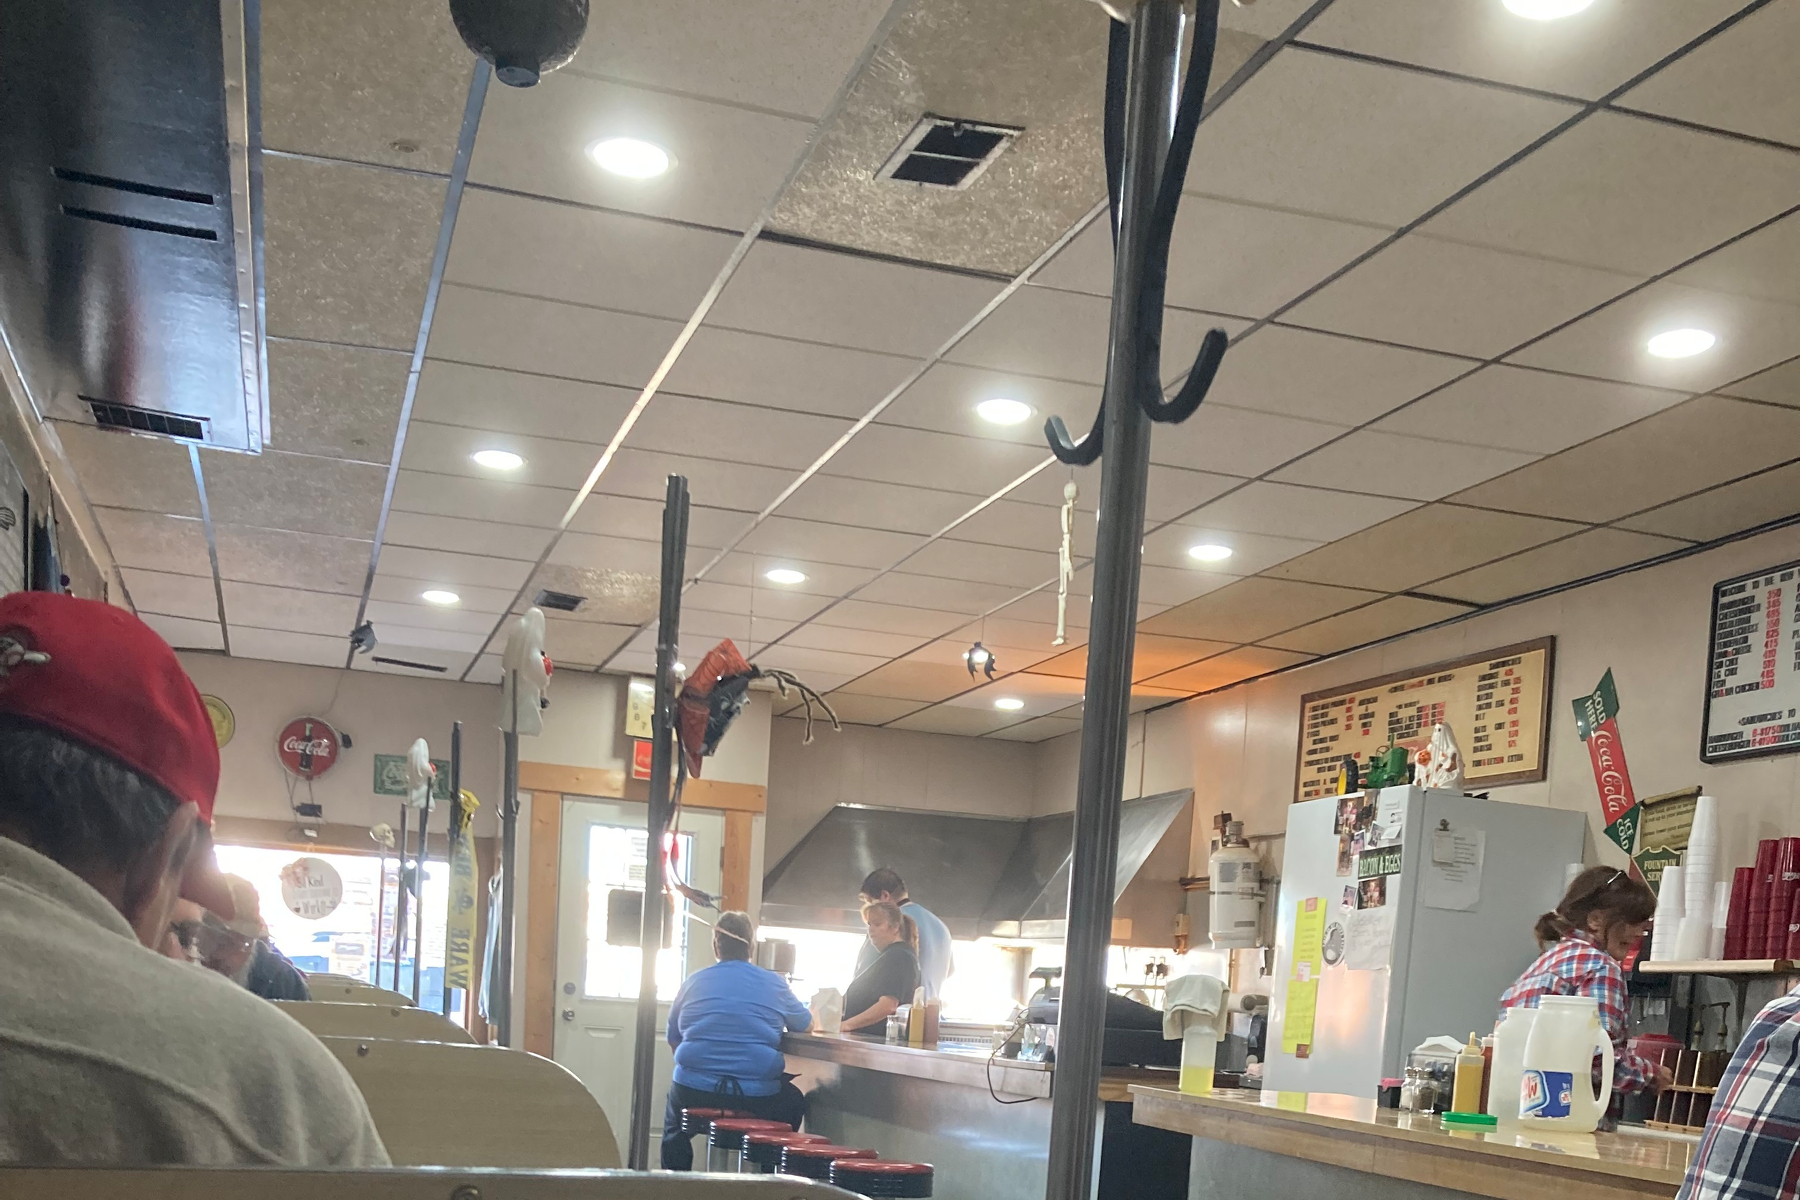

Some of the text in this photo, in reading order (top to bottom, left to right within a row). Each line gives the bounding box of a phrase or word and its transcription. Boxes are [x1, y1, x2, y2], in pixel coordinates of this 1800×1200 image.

[1585, 699, 1598, 731] HERE
[1593, 691, 1606, 724] SOLD
[1617, 818, 1629, 849] COLD
[1624, 818, 1634, 837] ICE
[1358, 853, 1401, 877] BACON & EGGS
[1644, 859, 1677, 870] FOUNTAIN
